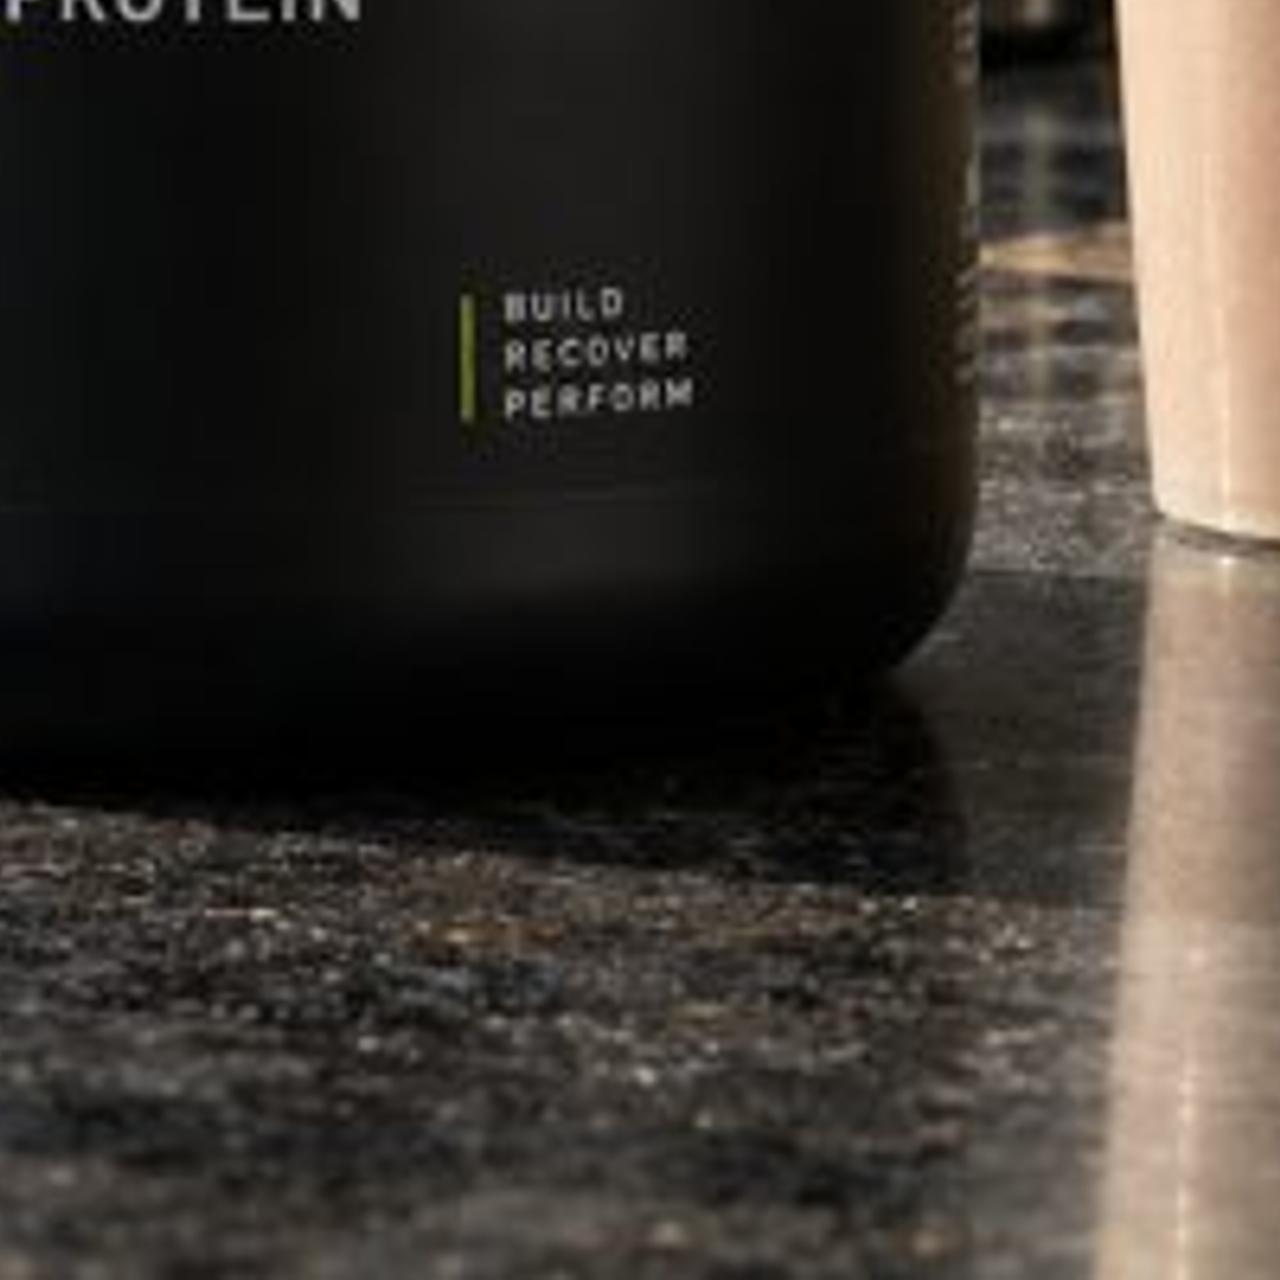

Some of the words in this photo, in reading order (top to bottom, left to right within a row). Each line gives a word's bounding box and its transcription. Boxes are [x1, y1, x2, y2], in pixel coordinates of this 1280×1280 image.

[503, 286, 624, 324] BUILD
[503, 330, 687, 372] RECOVER
[503, 378, 694, 419] PERFORM
